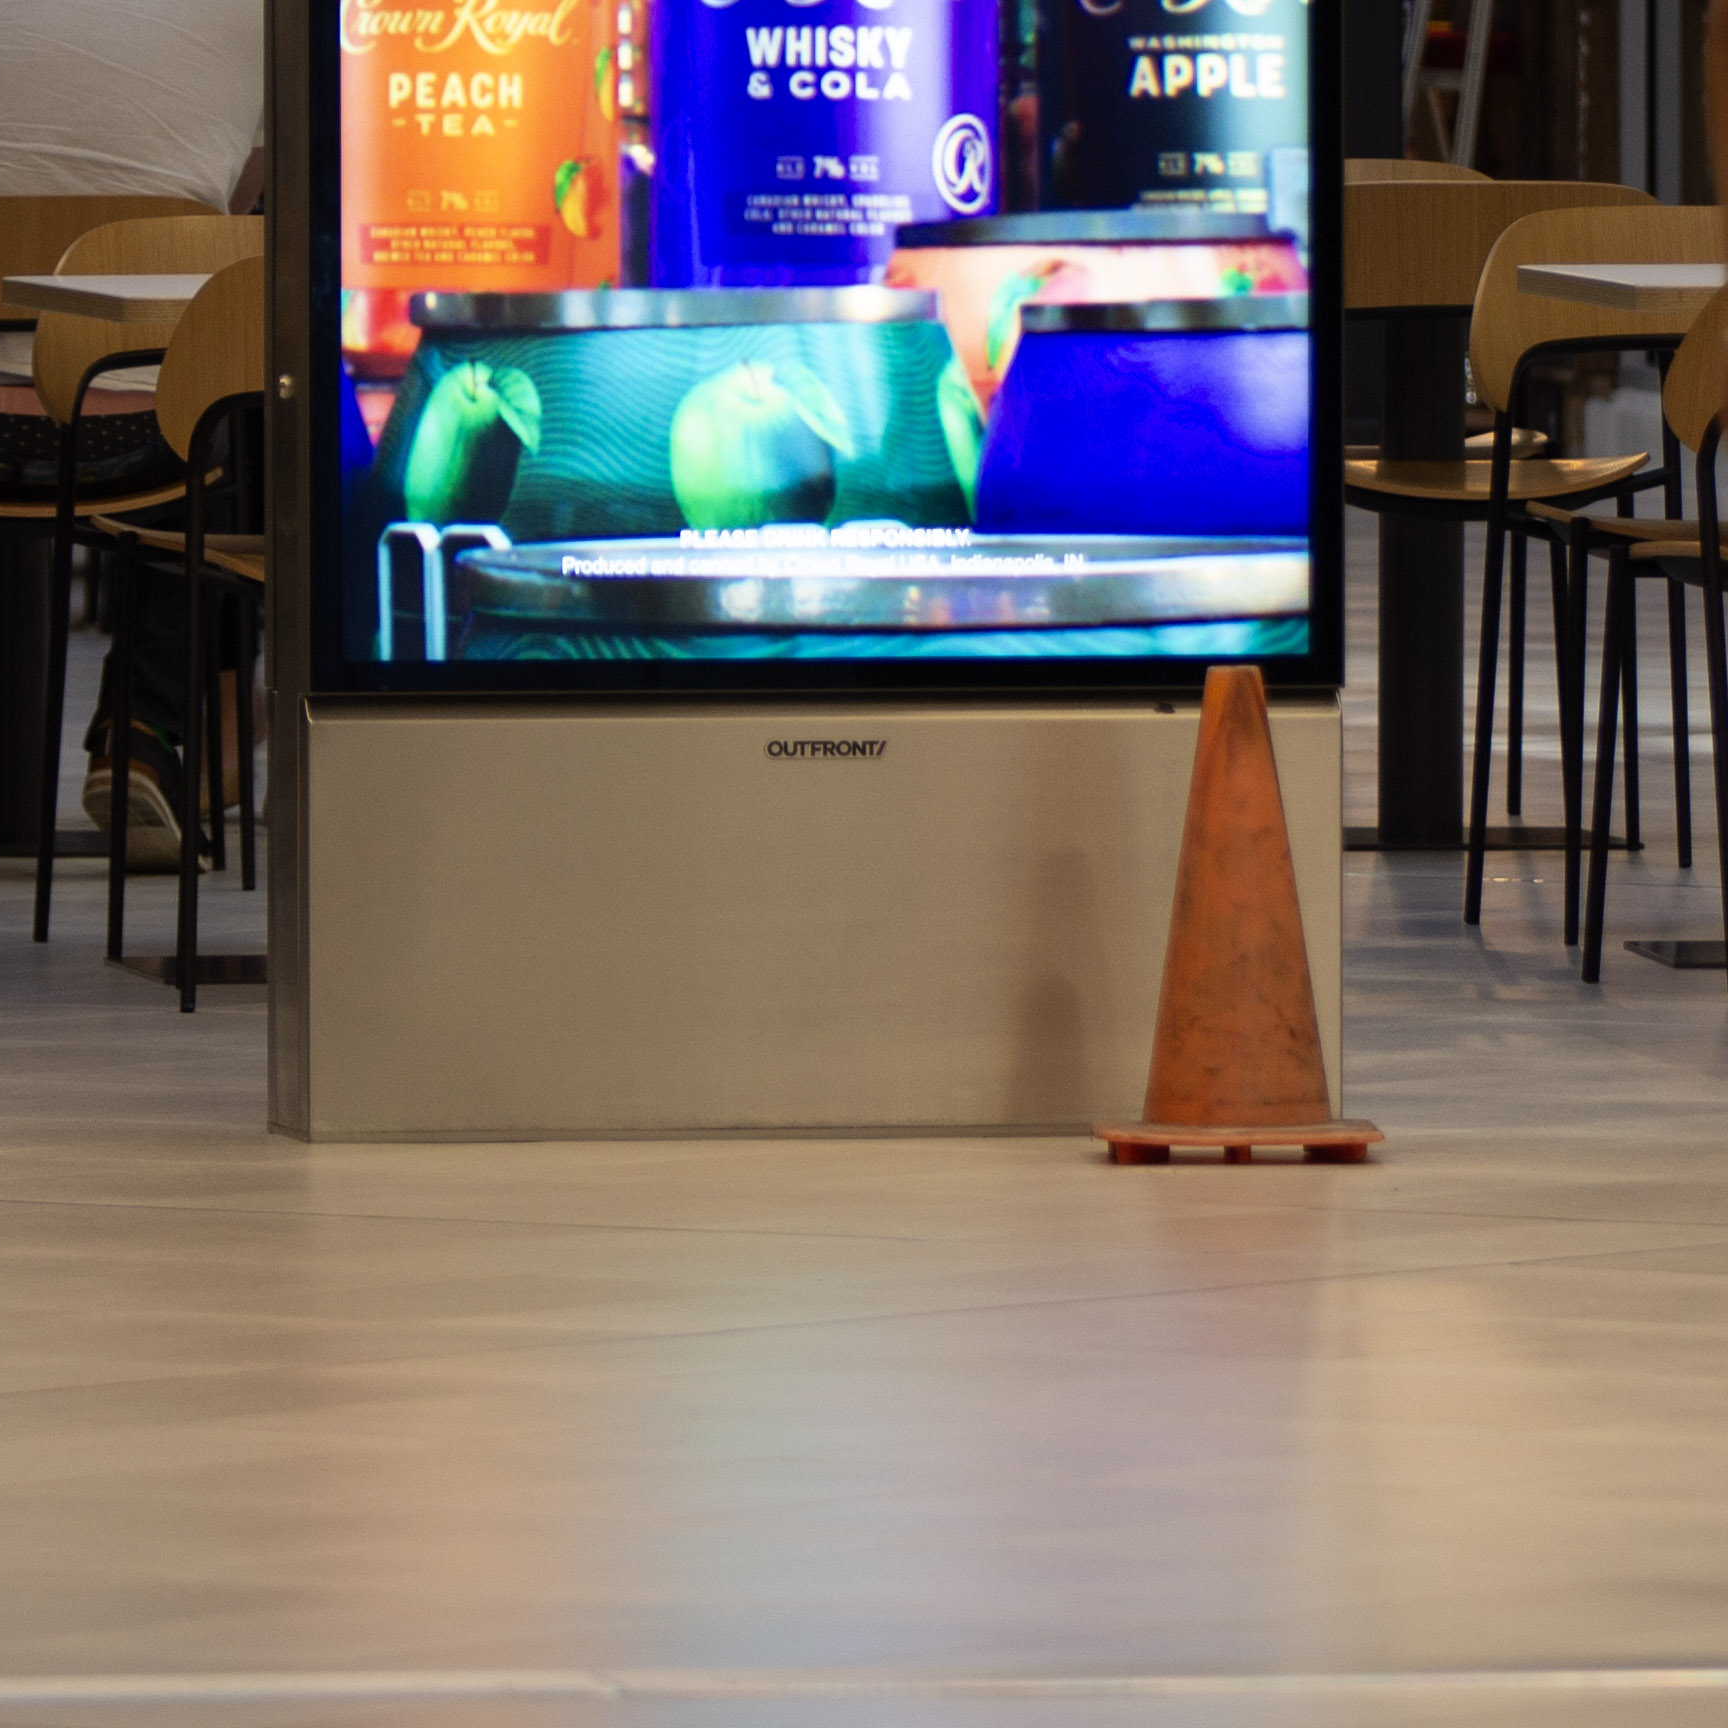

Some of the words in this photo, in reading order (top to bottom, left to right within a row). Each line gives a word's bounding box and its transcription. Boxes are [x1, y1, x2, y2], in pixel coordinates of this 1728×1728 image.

[745, 24, 913, 69] WHISKY
[388, 72, 523, 110] PEACH
[746, 70, 774, 100] &
[788, 70, 913, 101] COLA
[1128, 53, 1286, 99] APPLE
[414, 113, 496, 138] TEA
[561, 556, 647, 576] Produced
[651, 556, 685, 576] and
